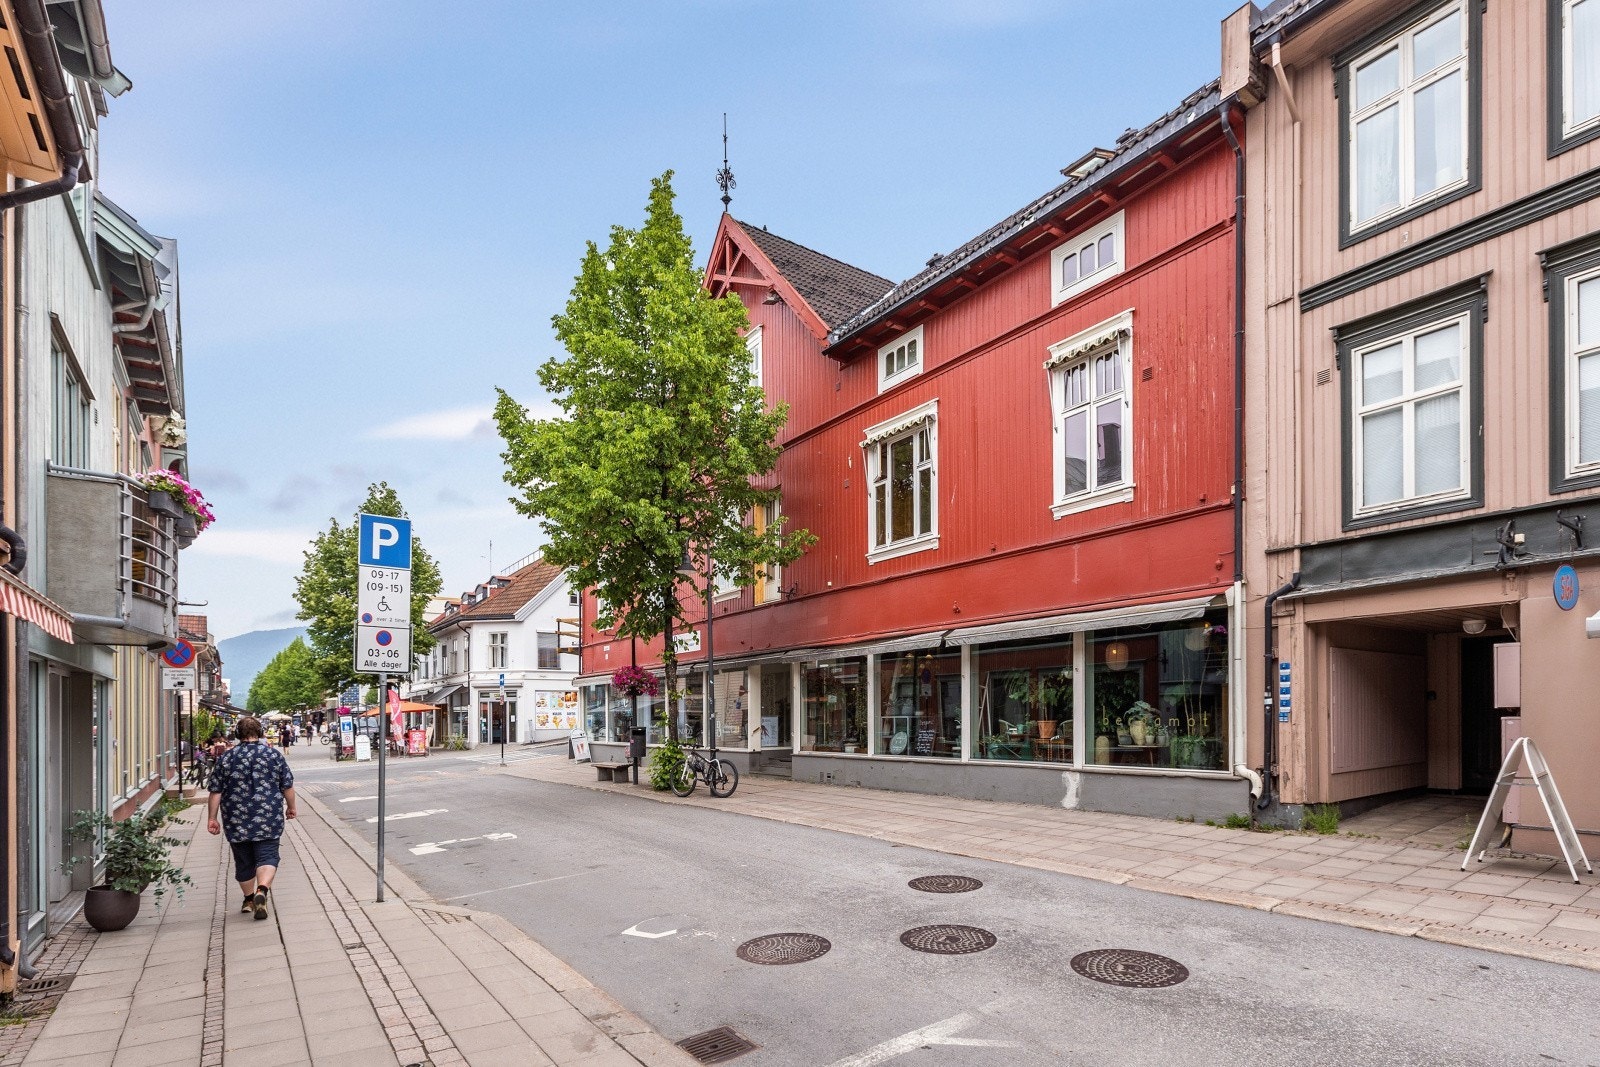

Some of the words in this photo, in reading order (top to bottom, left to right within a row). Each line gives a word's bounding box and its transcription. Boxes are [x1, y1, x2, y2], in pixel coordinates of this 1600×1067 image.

[372, 522, 399, 560] P
[371, 570, 399, 580] 09-17
[366, 582, 403, 594] (09-15)
[367, 648, 400, 658] 03-06
[364, 660, 378, 668] Alle
[381, 660, 402, 670] dager
